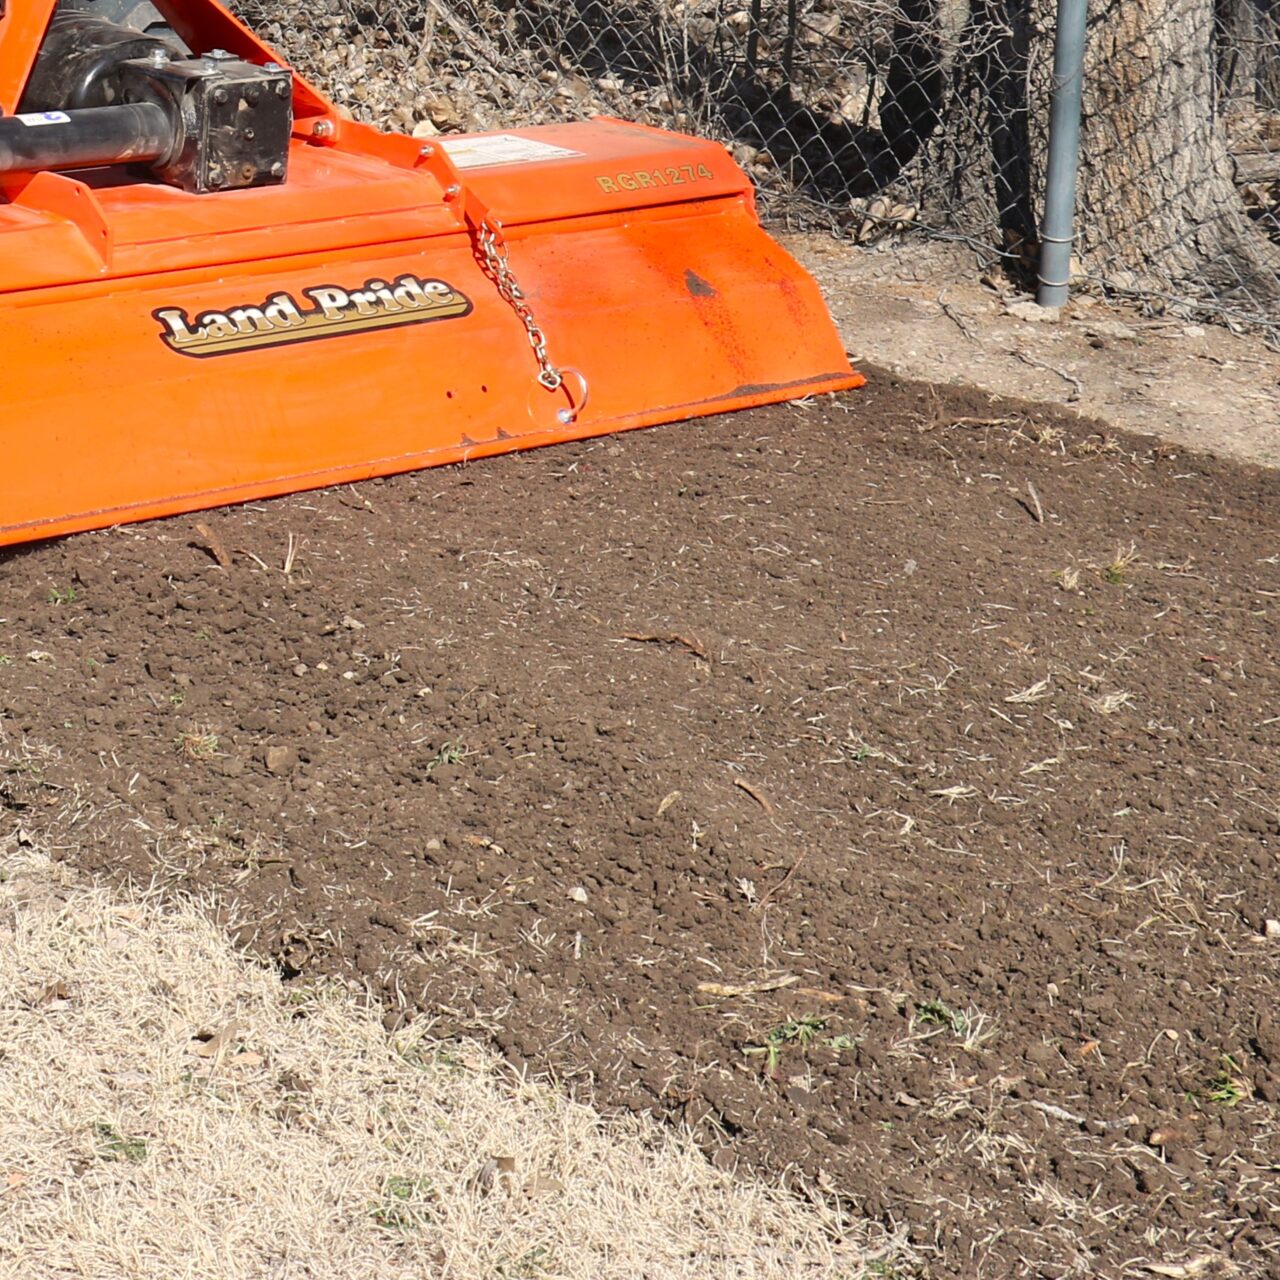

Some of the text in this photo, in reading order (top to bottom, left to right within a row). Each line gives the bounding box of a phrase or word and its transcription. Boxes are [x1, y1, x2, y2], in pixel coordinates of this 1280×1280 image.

[595, 163, 713, 195] RGR1274
[157, 274, 456, 344] Land Pride
